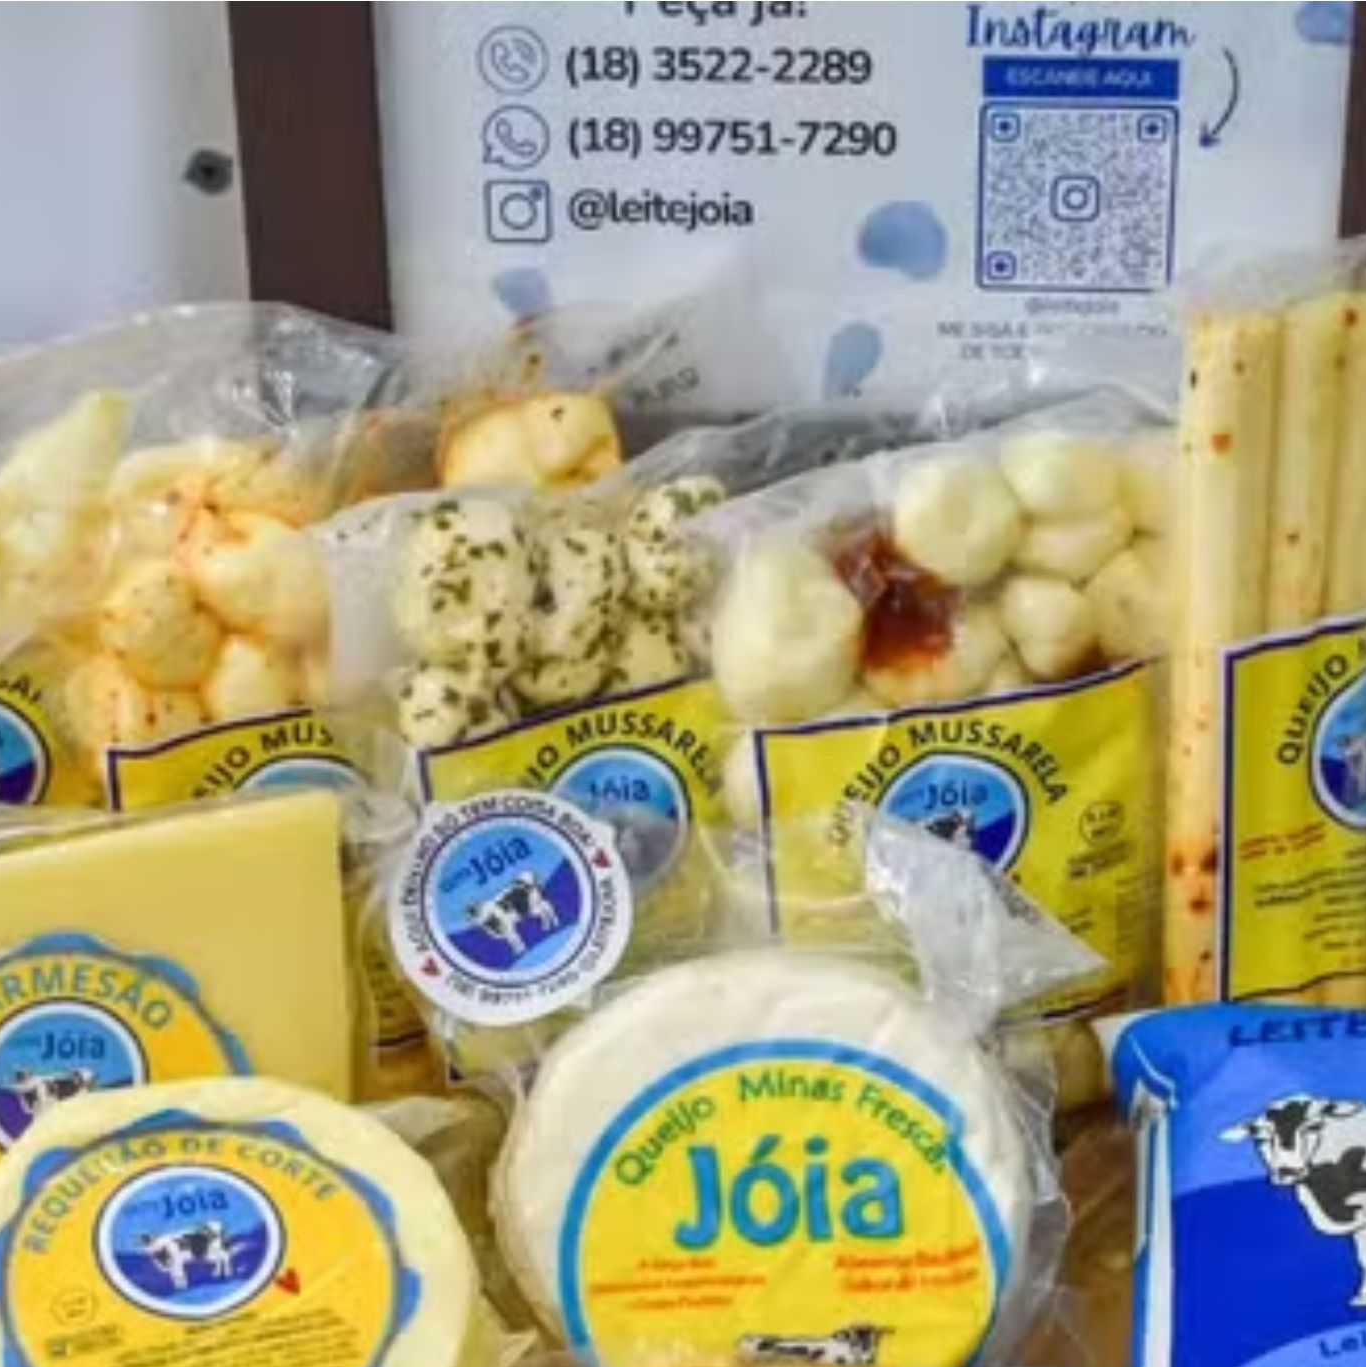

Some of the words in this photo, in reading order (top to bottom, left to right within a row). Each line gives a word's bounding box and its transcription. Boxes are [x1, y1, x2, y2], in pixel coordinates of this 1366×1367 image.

[965, 4, 1196, 58] Instagram
[566, 45, 640, 88] (18)
[652, 47, 873, 85] 3522-2289
[568, 117, 642, 160] (18)
[652, 119, 898, 156] 99751-7290
[567, 188, 755, 232] @leitejoia
[908, 719, 1068, 805] MUSSARELA
[924, 778, 989, 811] Jóia
[468, 836, 534, 886] Jóia
[41, 1031, 107, 1061] Jóia
[613, 1095, 717, 1188] Queijo
[738, 1069, 847, 1105] Minas
[180, 1136, 222, 1156] DE
[237, 1141, 342, 1202] CORTE
[673, 1133, 905, 1252] Jóia
[161, 1186, 231, 1220] Jóia
